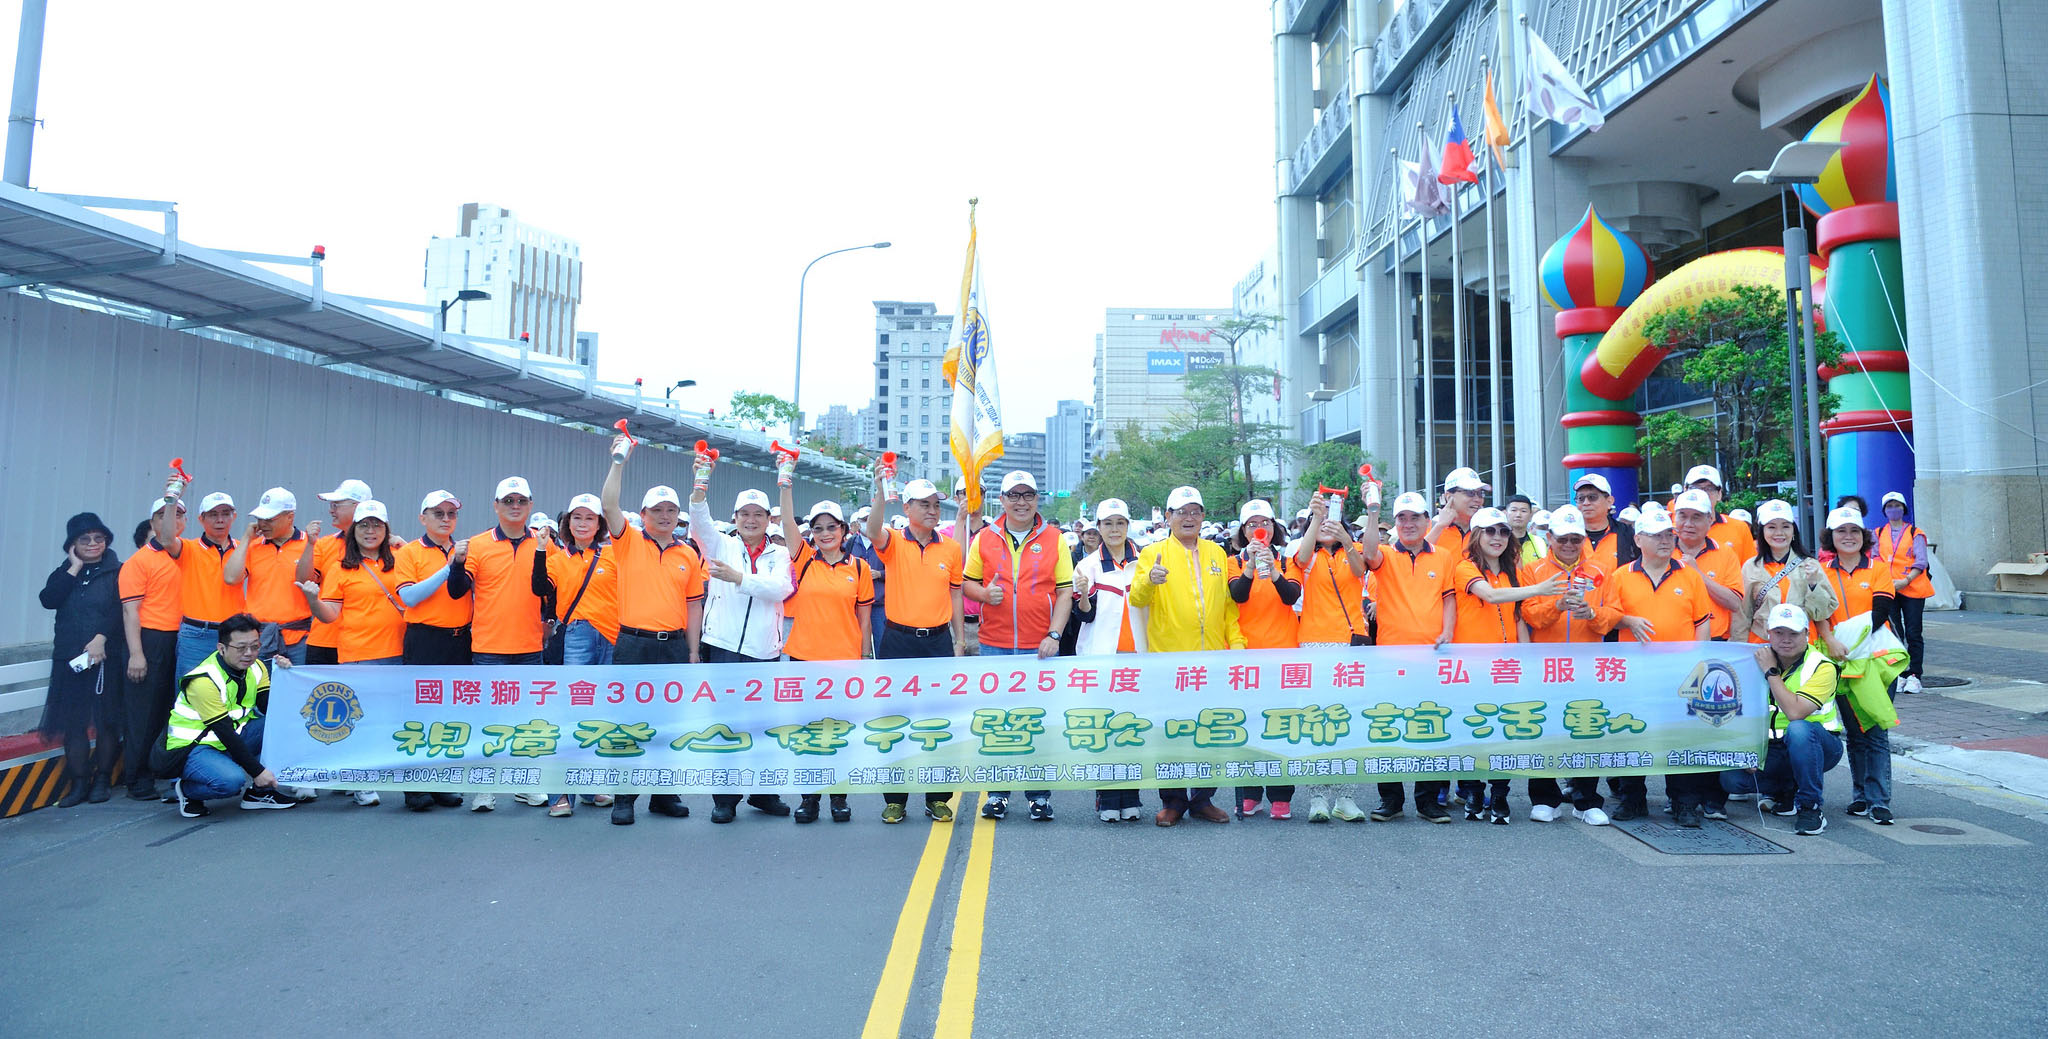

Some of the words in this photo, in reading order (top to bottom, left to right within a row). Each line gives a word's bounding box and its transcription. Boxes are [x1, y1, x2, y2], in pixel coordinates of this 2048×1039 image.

[1151, 358, 1182, 366] IMAX
[1200, 356, 1222, 365] Dolby
[316, 683, 352, 698] LIONS
[414, 667, 1143, 706] 國際獅子會300A-2區2024-2025年度
[324, 700, 342, 723] L
[392, 699, 1648, 758] 視障登山健行暨歌唱聯誼活動
[1287, 758, 1358, 777] 視力委員會
[1364, 755, 1476, 774] 糖尿病防治委員會
[1666, 750, 1760, 769] 台北市啟明學校
[468, 768, 496, 785] 總監
[500, 768, 541, 785] 黃朝慶
[759, 768, 788, 786] 主席
[793, 768, 836, 786] 王正凱
